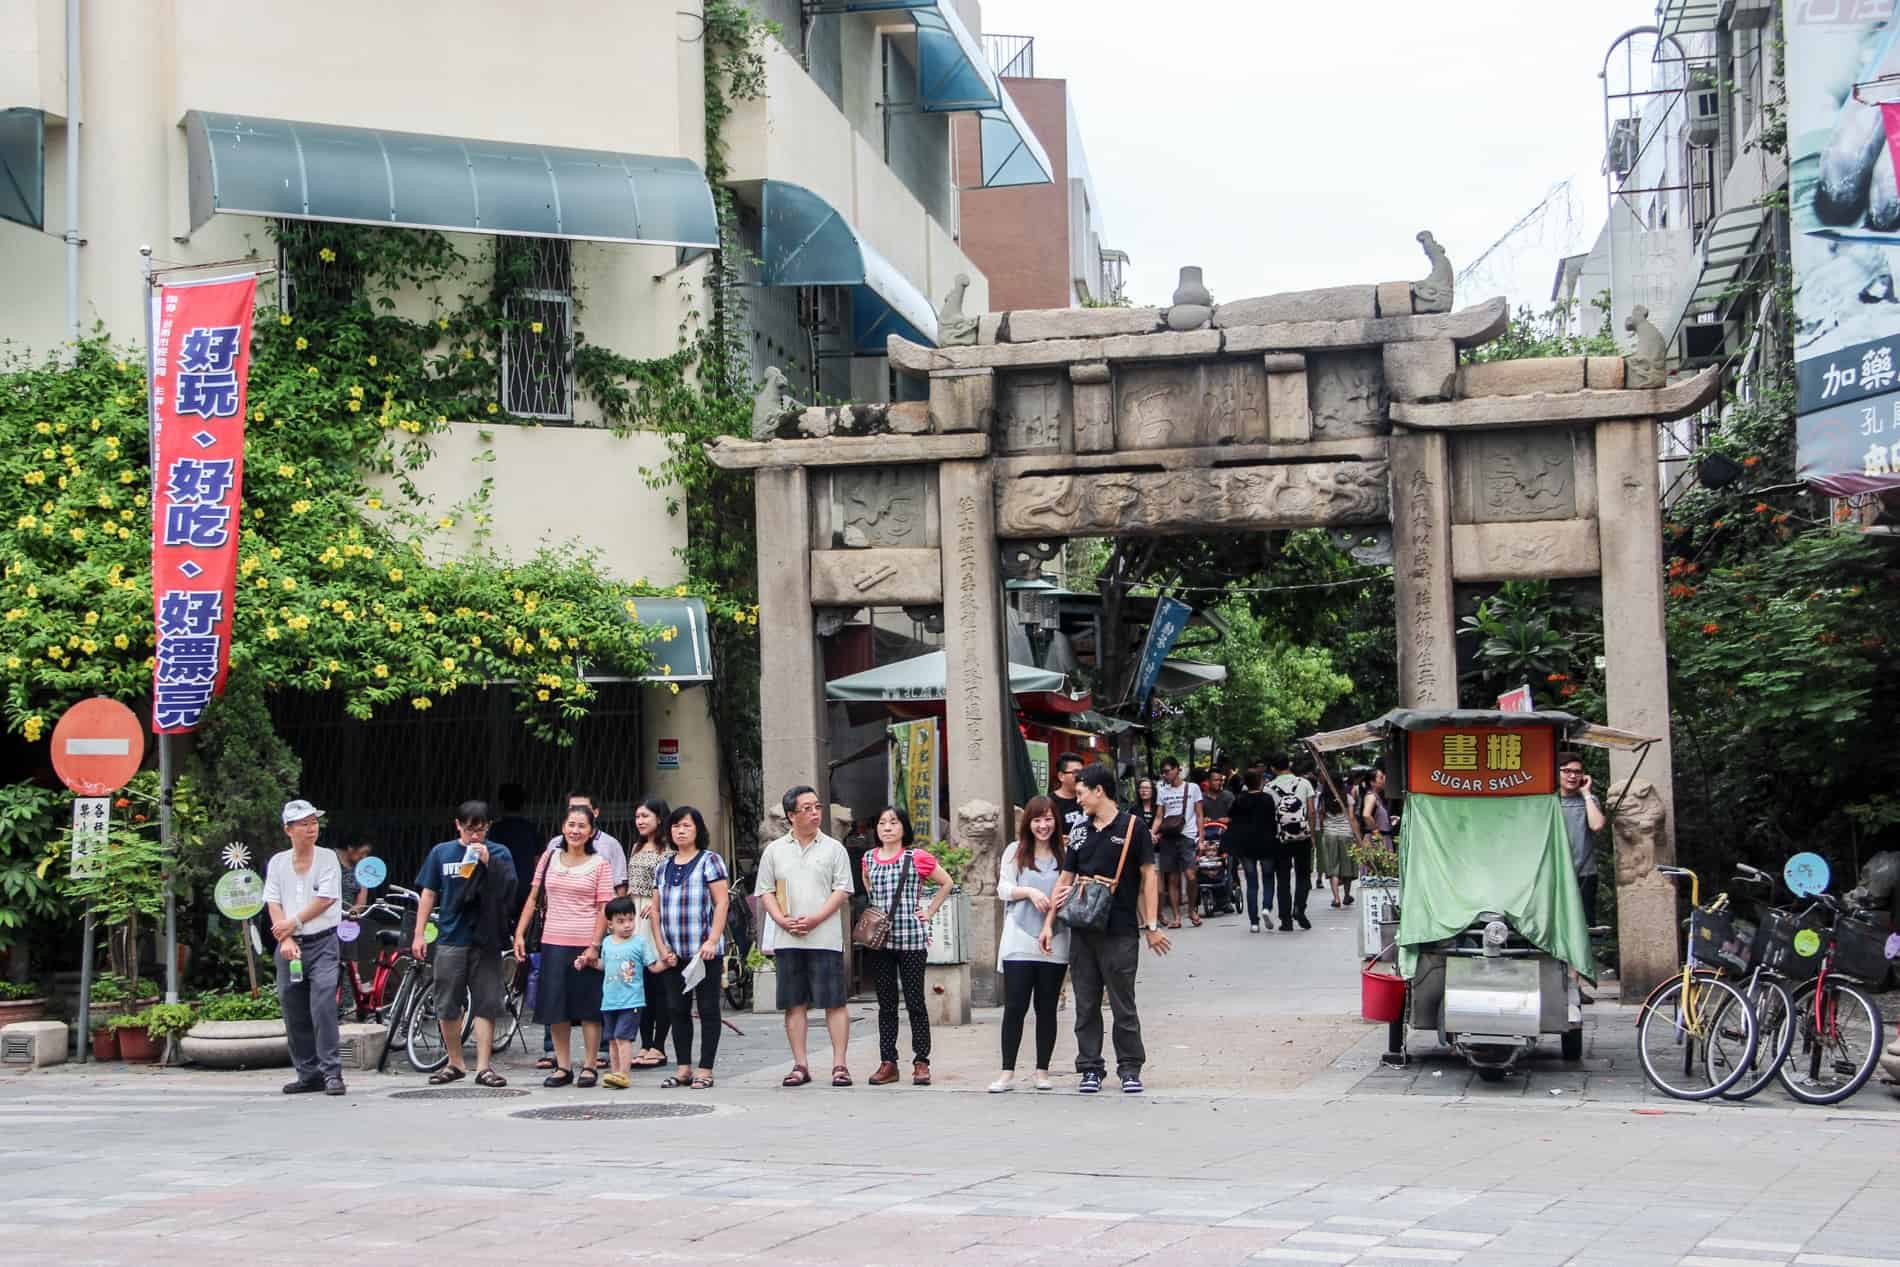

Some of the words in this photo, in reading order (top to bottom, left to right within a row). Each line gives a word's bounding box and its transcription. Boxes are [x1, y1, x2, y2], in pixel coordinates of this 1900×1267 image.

[177, 326, 240, 419] 好玩
[1821, 346, 1900, 399] 加藥
[163, 457, 234, 547] 好吃
[156, 590, 223, 728] 好漂亮
[1430, 769, 1483, 792] SUGAR
[1488, 770, 1534, 791] SKILL
